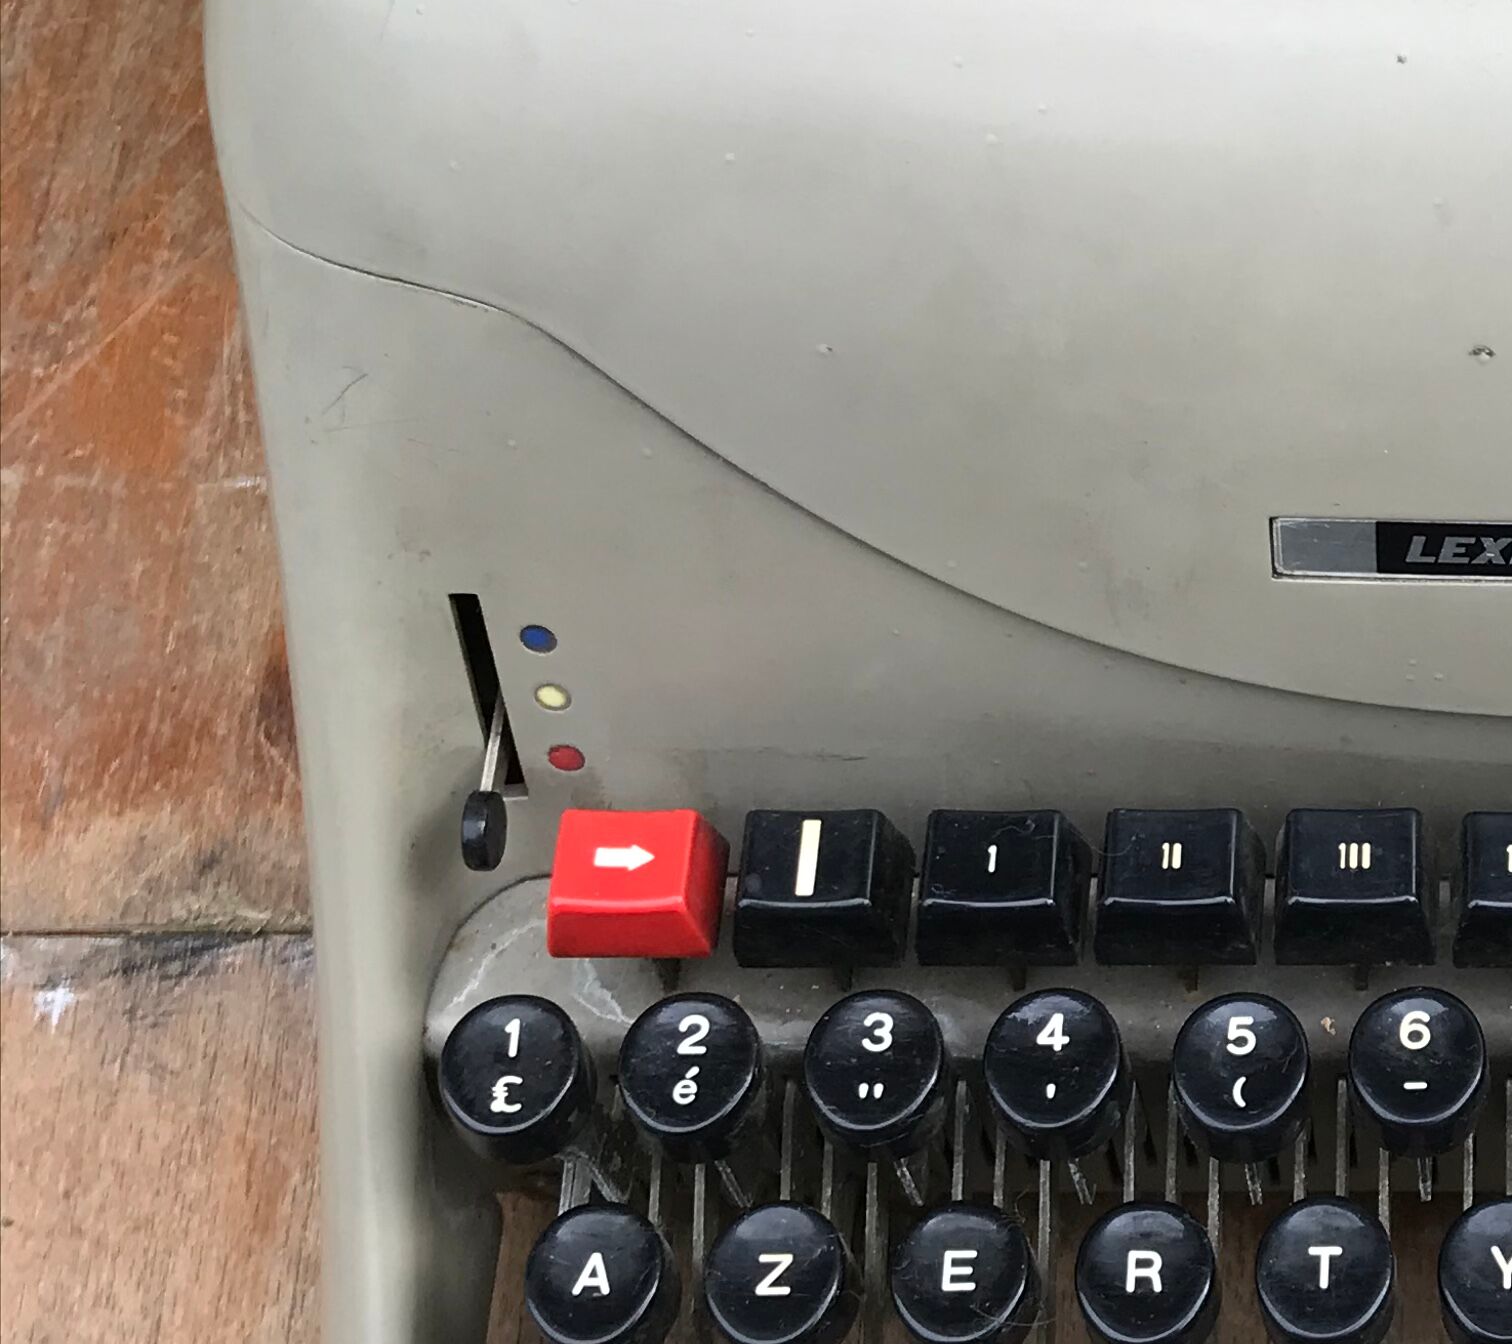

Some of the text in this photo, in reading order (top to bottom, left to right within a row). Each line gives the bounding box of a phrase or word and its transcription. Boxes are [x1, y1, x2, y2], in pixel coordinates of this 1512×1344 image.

[504, 1018, 521, 1058] 1
[676, 1014, 710, 1055] 2
[861, 1011, 894, 1052] 3
[1036, 1012, 1070, 1052] 4
[1226, 1015, 1257, 1056] 5
[1399, 1010, 1431, 1050] 6
[490, 1075, 523, 1113] £
[672, 1066, 700, 1105] é
[571, 1252, 610, 1296] A
[754, 1253, 794, 1296] Z
[941, 1249, 978, 1292] E
[1125, 1249, 1163, 1293] R
[1307, 1245, 1343, 1290] T
